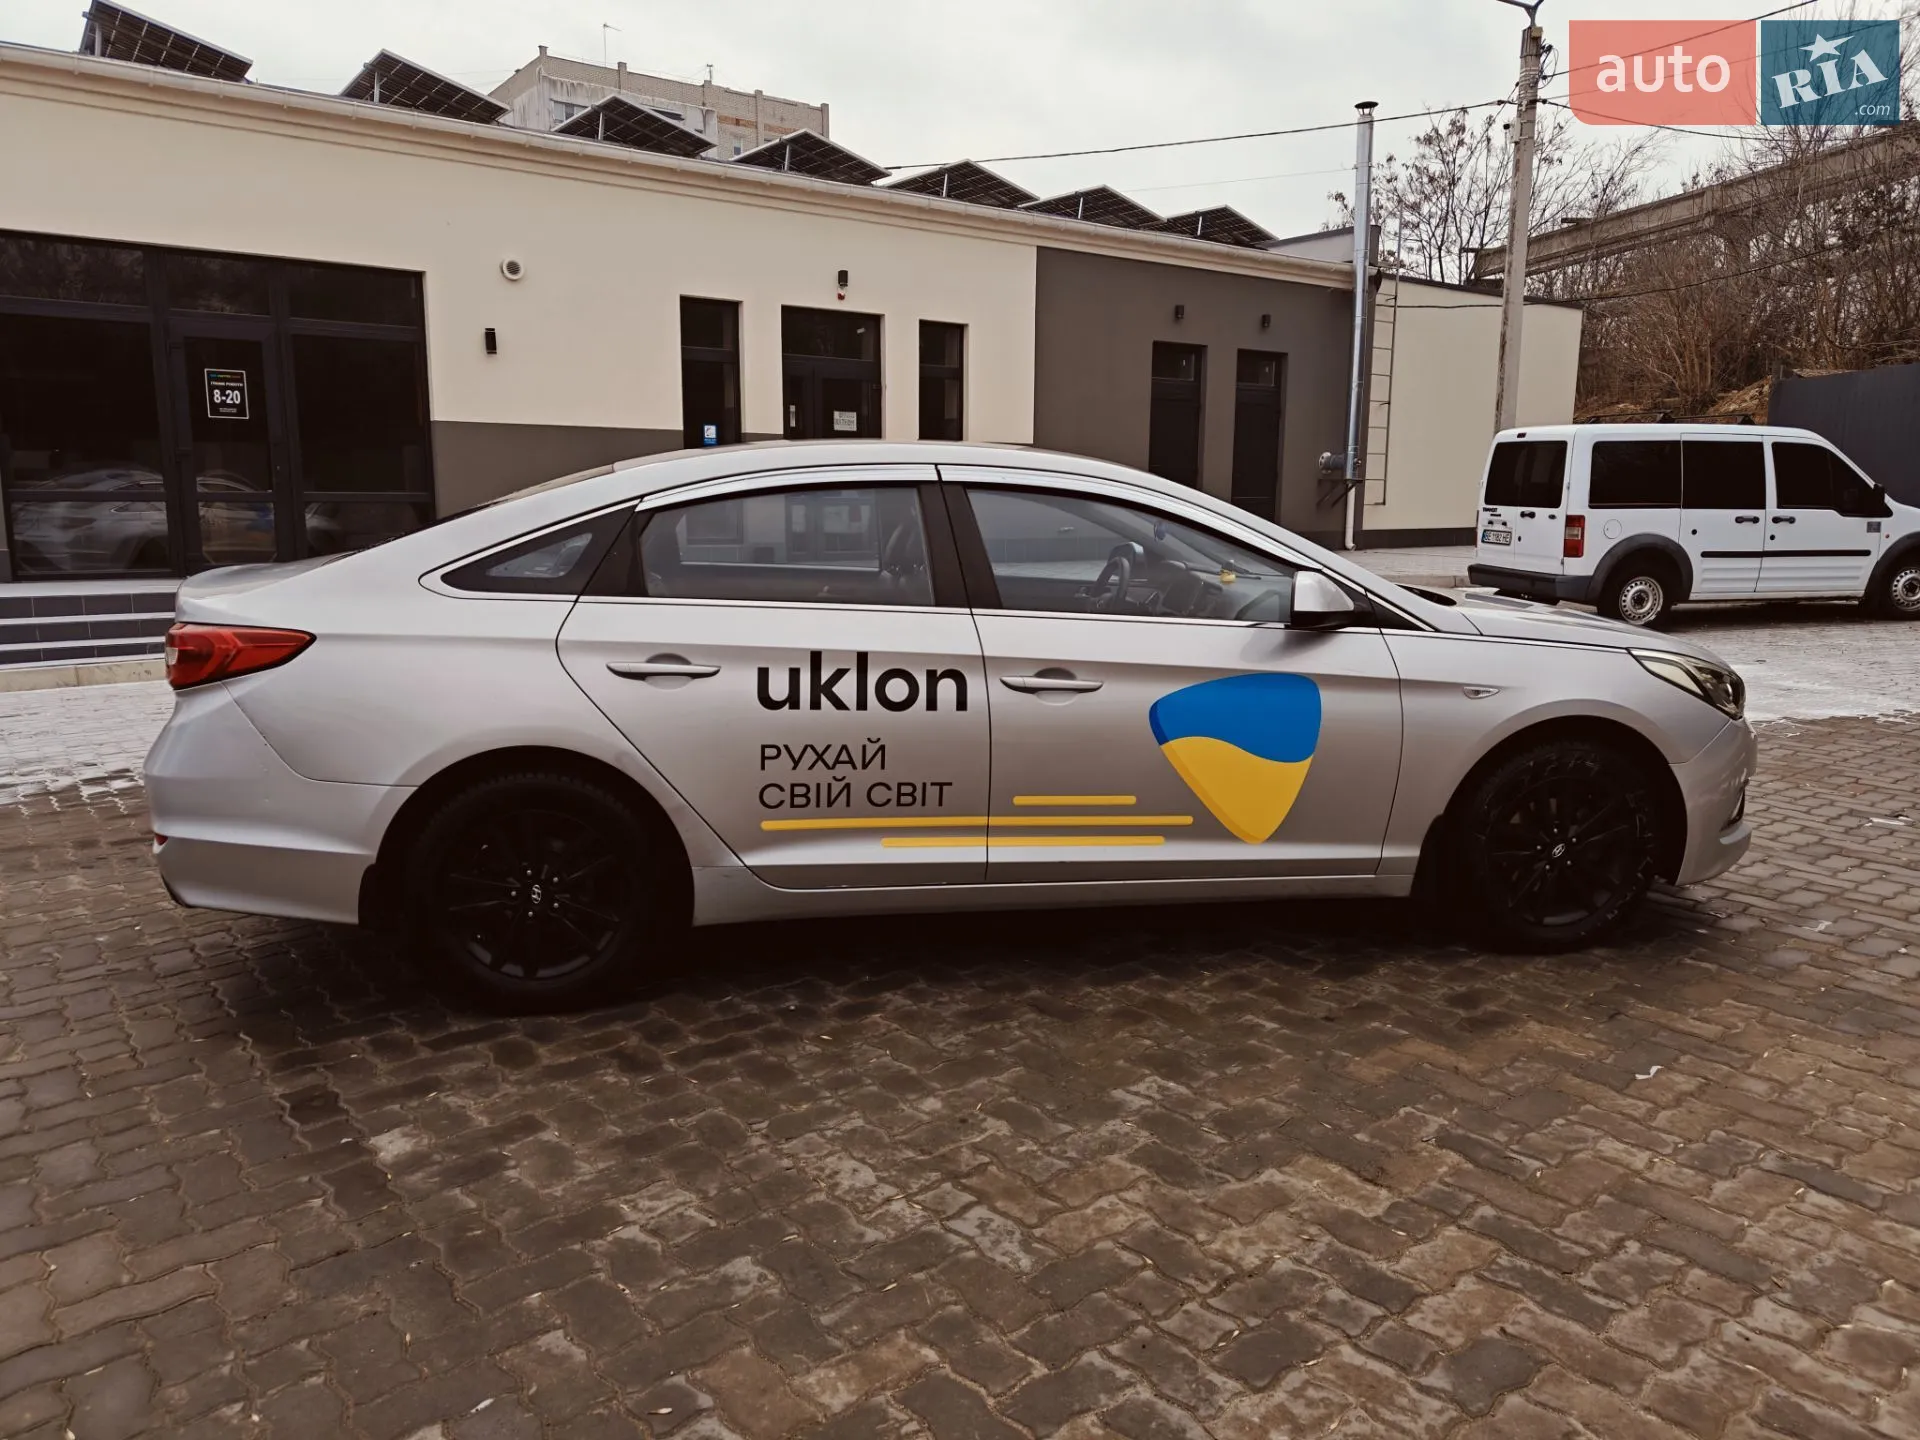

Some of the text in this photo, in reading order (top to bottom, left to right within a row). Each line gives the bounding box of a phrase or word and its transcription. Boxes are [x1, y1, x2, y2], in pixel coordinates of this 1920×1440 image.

[213, 389, 241, 404] 8-20
[757, 650, 968, 712] uklon
[760, 737, 887, 771] РУХАЙ
[758, 775, 953, 809] СВІЙ СВІТ
